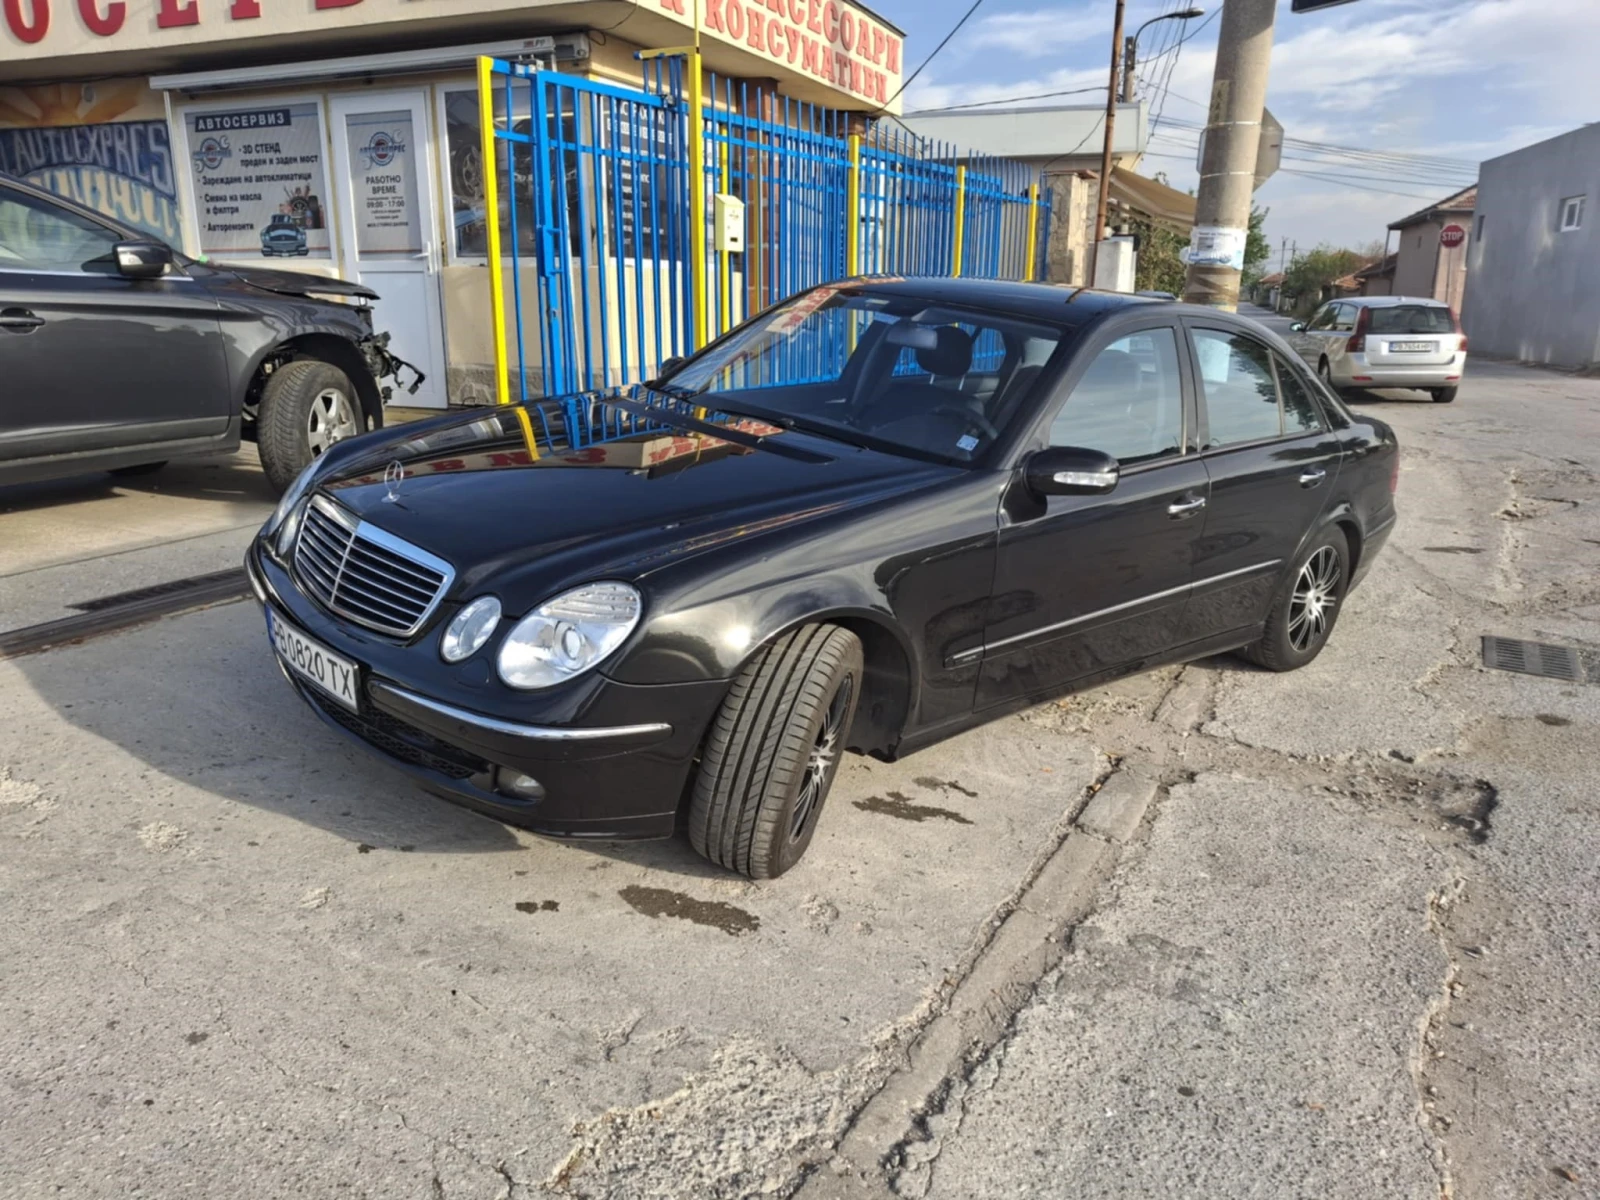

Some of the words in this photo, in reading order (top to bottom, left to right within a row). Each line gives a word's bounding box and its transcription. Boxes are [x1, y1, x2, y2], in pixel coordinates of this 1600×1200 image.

[754, 0, 899, 74] СЕСОАРИ
[704, 0, 888, 104] КОНСУМАТИВИ
[198, 112, 285, 130] АВТОСЕРВИЗ
[255, 142, 282, 154] СТЕНД
[299, 155, 318, 164] мост
[365, 174, 402, 184] РАБОТНО
[372, 185, 397, 195] ВРЕМЕ
[240, 193, 262, 202] масла
[1442, 231, 1463, 241] STOP
